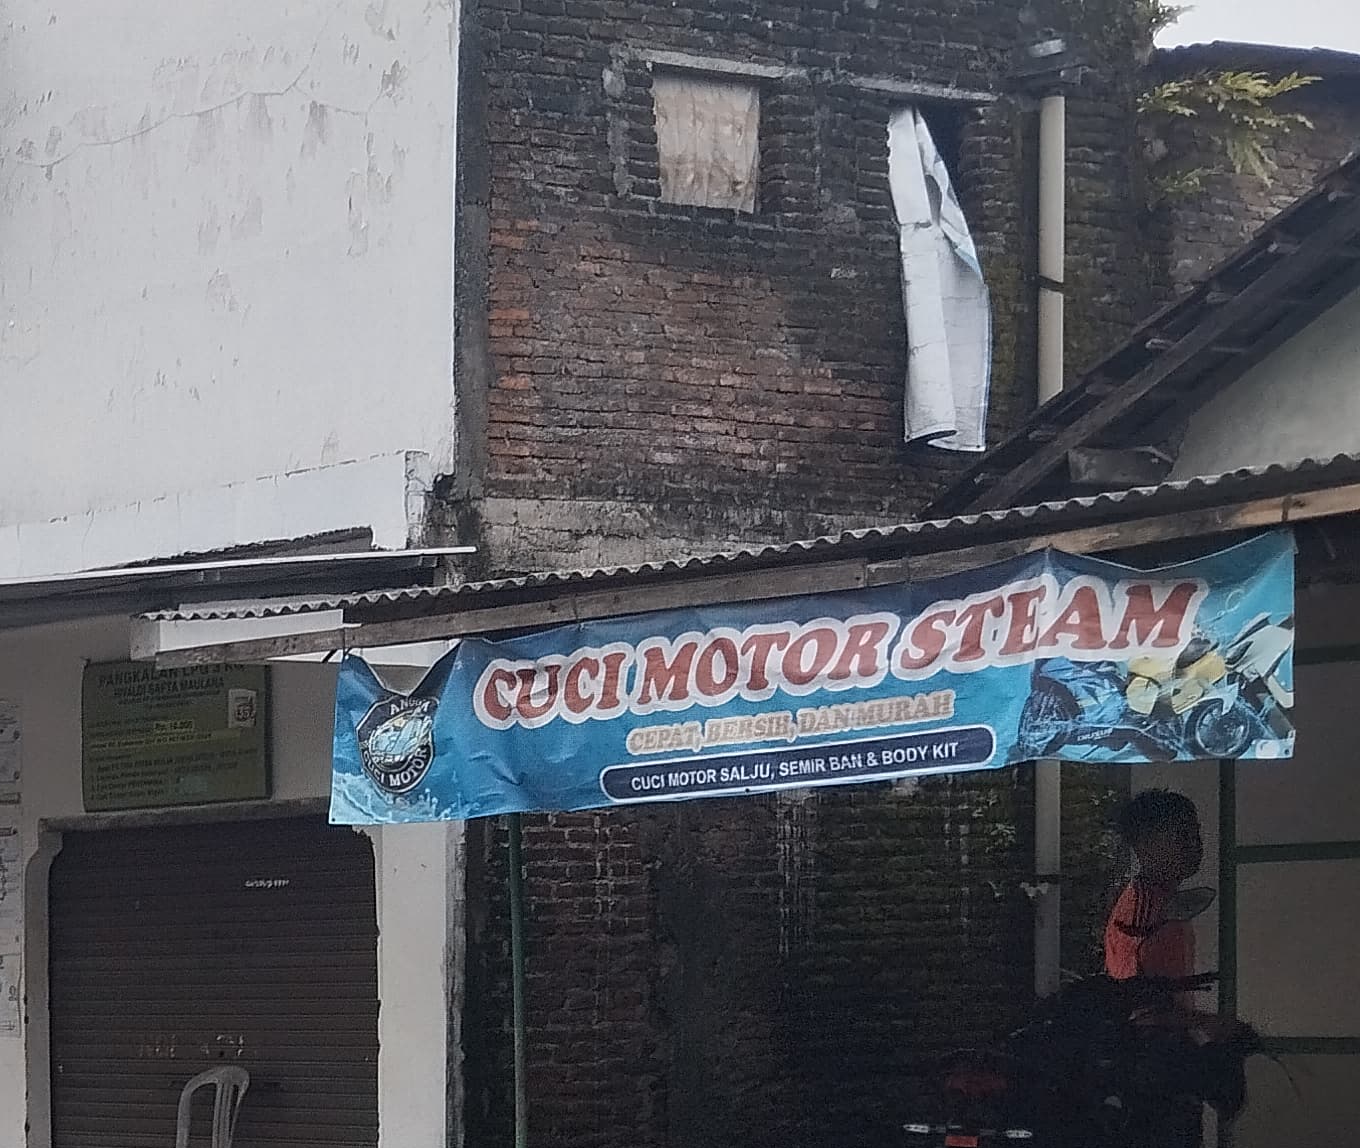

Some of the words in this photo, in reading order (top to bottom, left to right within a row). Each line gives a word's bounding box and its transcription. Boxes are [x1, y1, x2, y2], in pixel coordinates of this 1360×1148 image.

[483, 653, 626, 720] CUCI
[637, 622, 889, 705] MOTOR
[900, 582, 1199, 669] STEAM
[630, 722, 702, 751] CEPAT,
[705, 713, 796, 742] BERSIH,
[798, 704, 849, 734] DAN
[850, 692, 953, 724] MURAH
[363, 750, 385, 783] CUCI
[389, 748, 427, 787] MOTOR
[631, 773, 665, 791] CUCI
[668, 769, 717, 787] MOTOR
[720, 764, 776, 782] SALJU,
[779, 758, 826, 777] SEMIR
[830, 755, 863, 771] BAN
[867, 752, 879, 767] &
[882, 746, 929, 765] BODY
[932, 742, 959, 759] KIT
